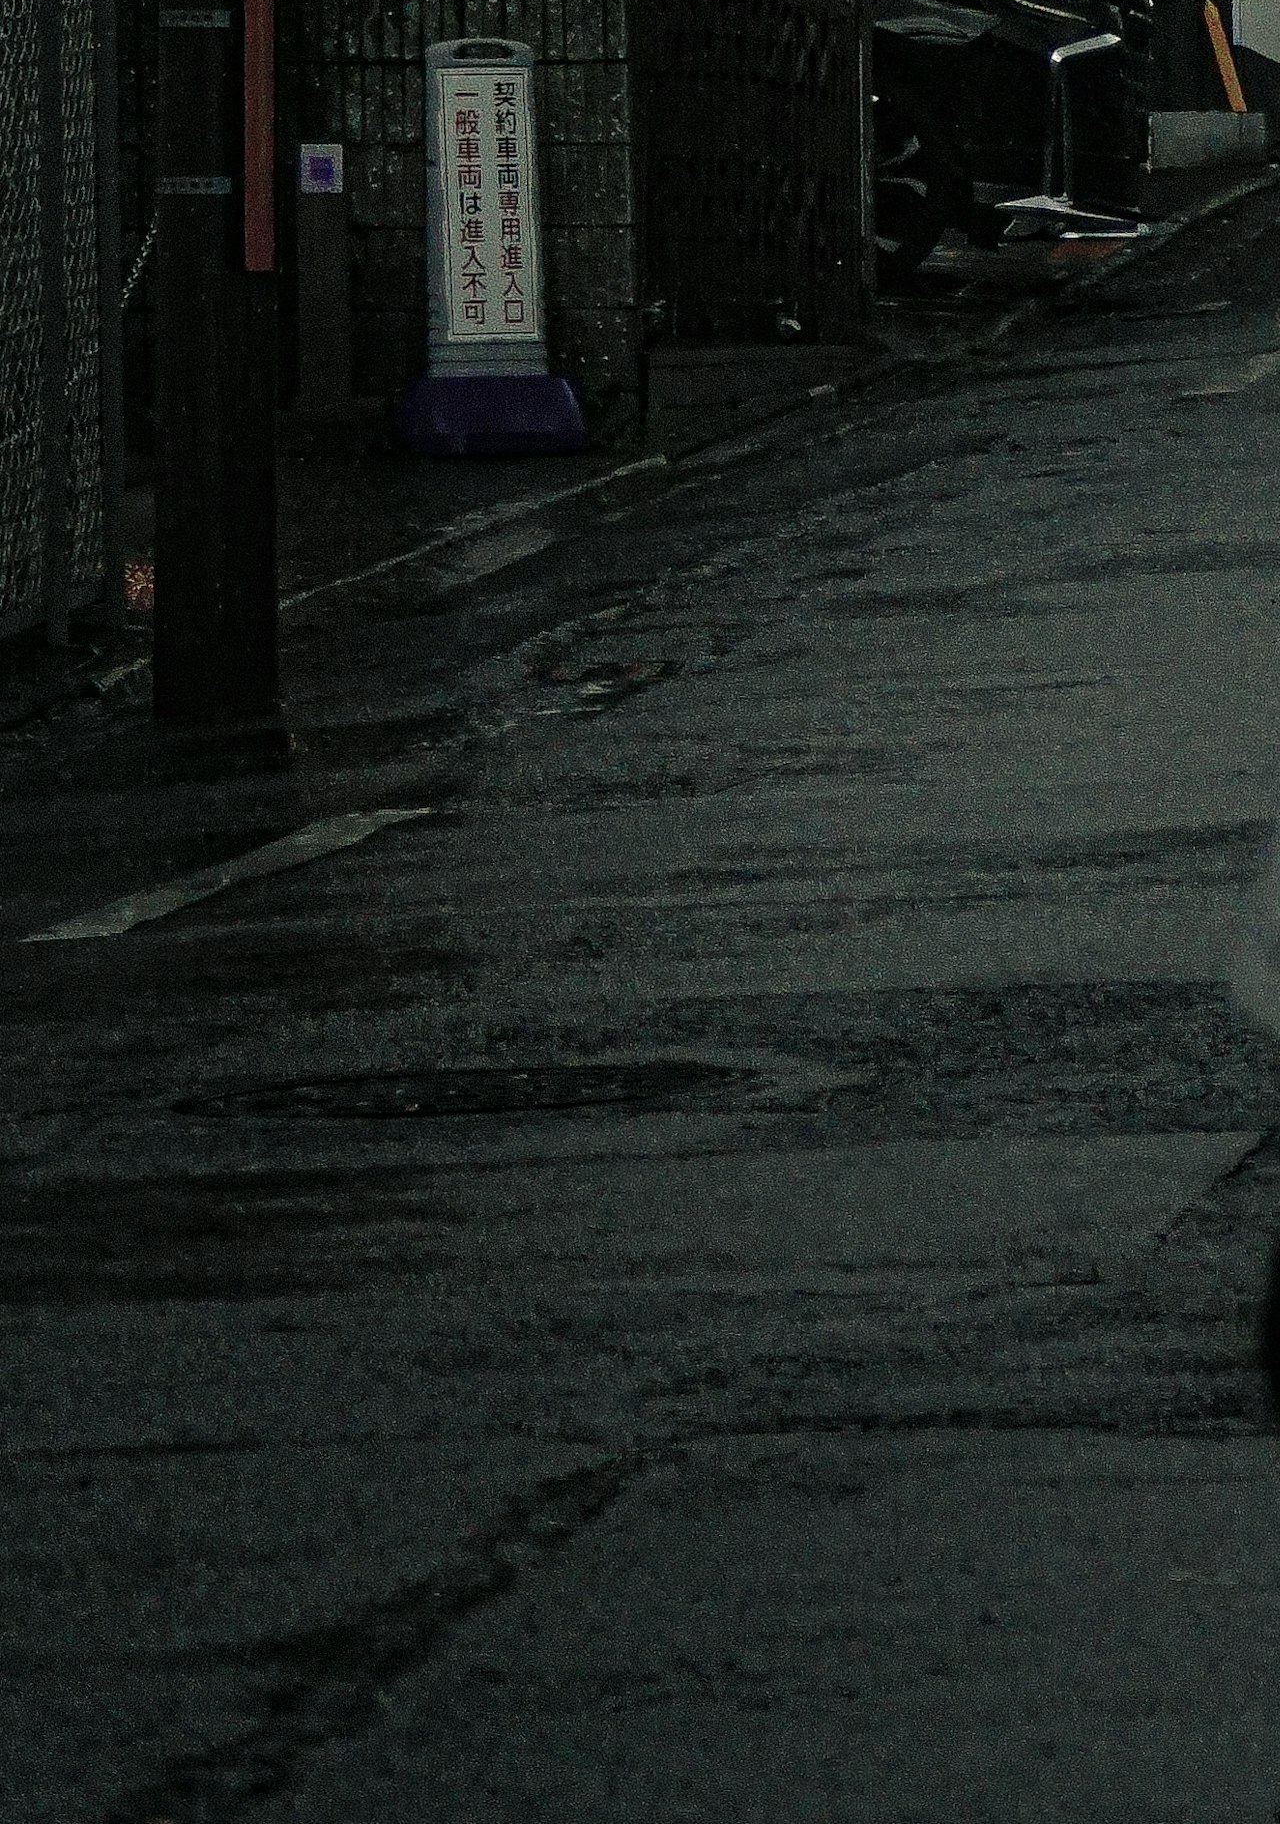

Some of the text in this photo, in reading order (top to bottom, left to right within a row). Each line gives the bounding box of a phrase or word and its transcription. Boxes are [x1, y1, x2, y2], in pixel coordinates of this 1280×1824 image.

[454, 91, 487, 325] 一般車両は進入不可
[492, 81, 525, 324] 契約車両専用進入口
